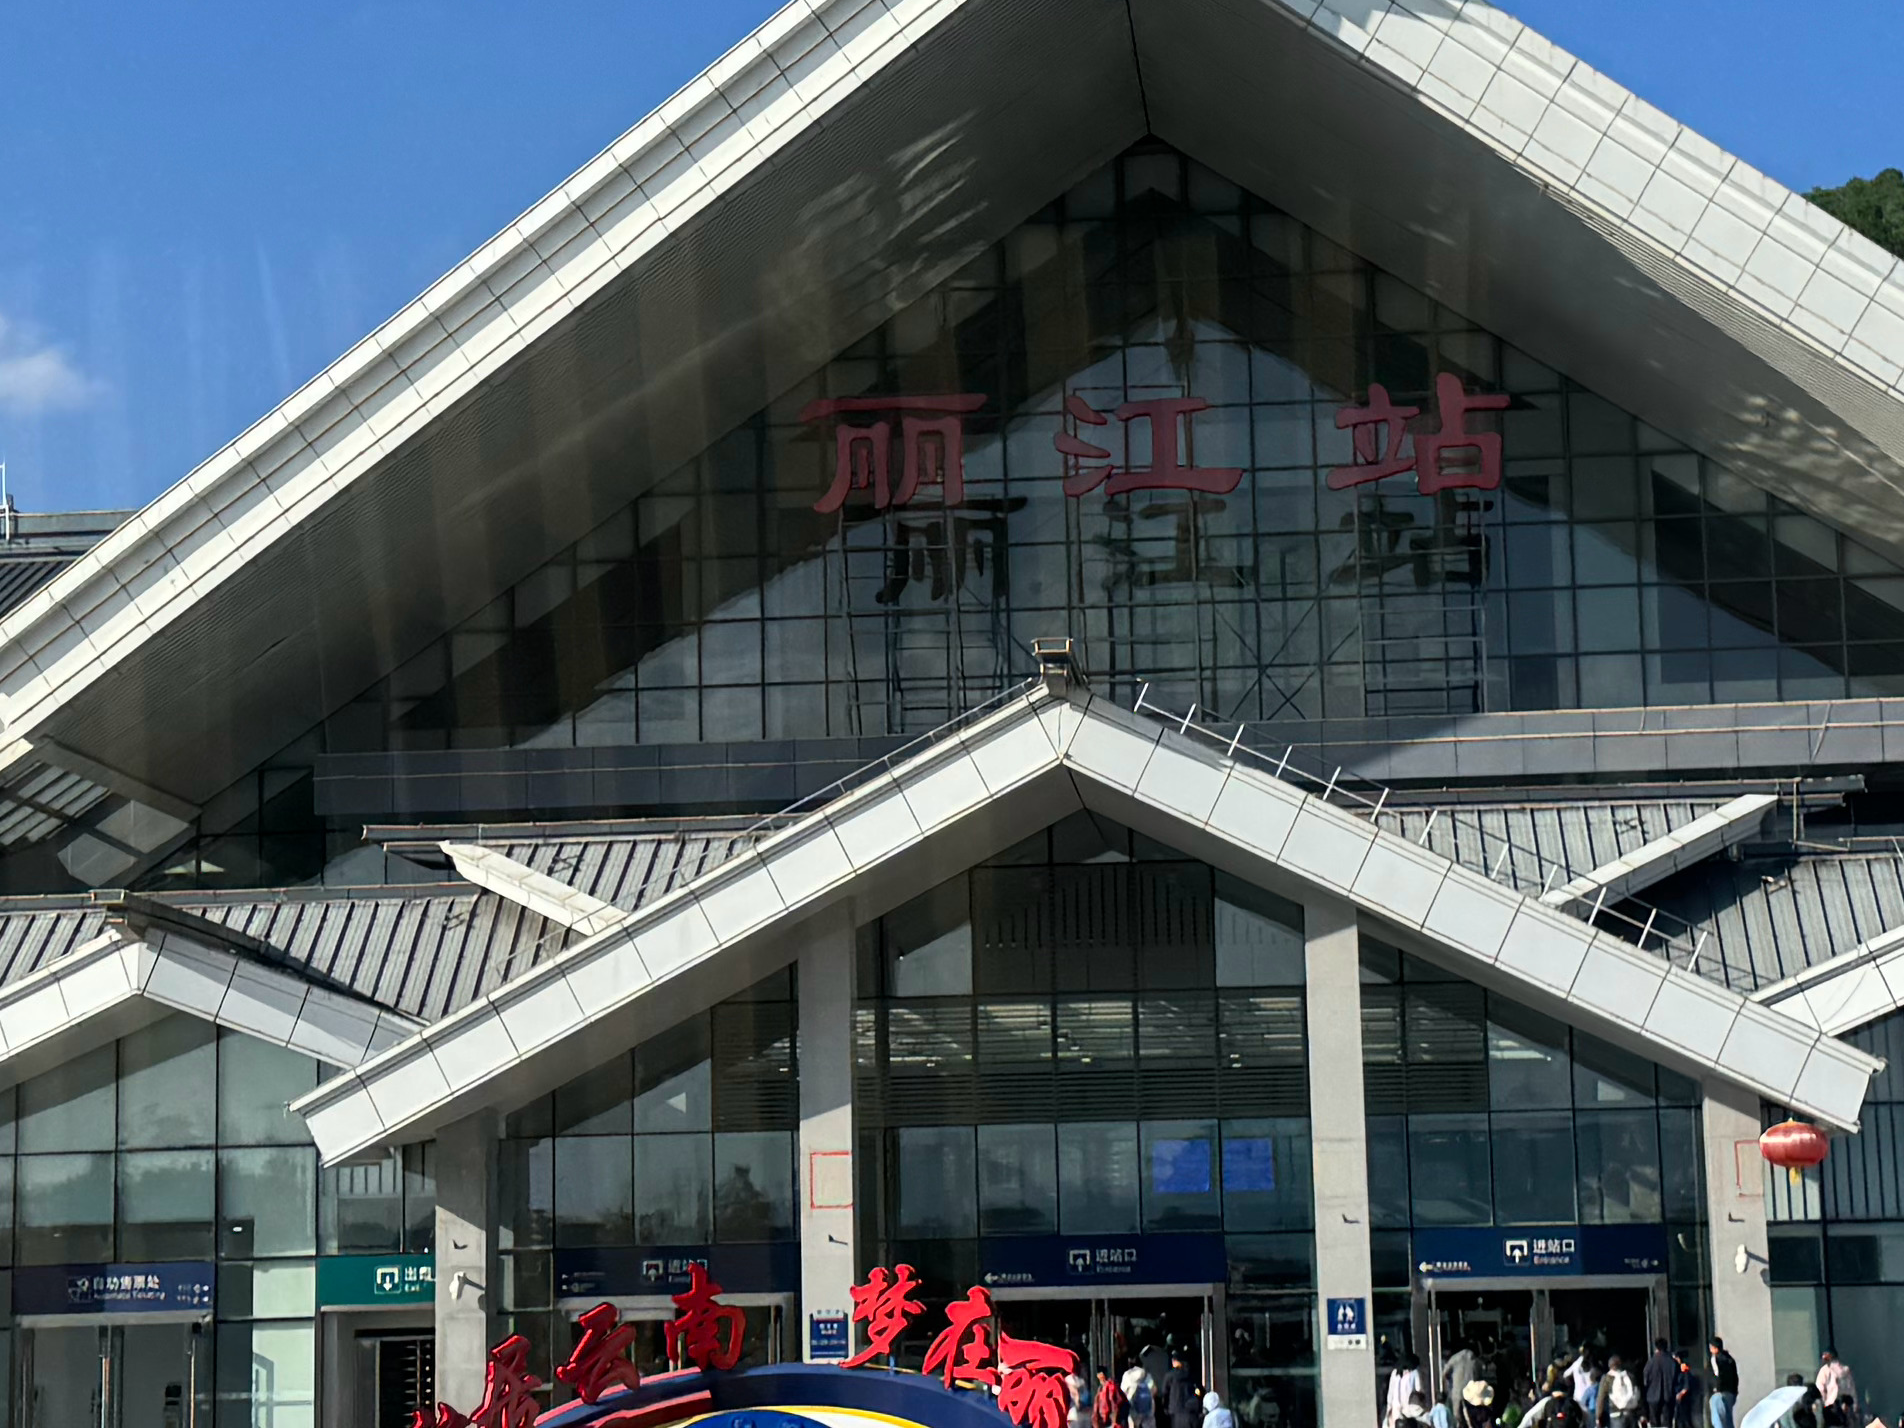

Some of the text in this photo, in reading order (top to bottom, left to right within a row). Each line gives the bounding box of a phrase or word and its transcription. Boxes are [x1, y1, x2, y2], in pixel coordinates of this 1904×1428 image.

[799, 372, 1510, 513] 丽江站
[1533, 1238, 1575, 1254] 进站口
